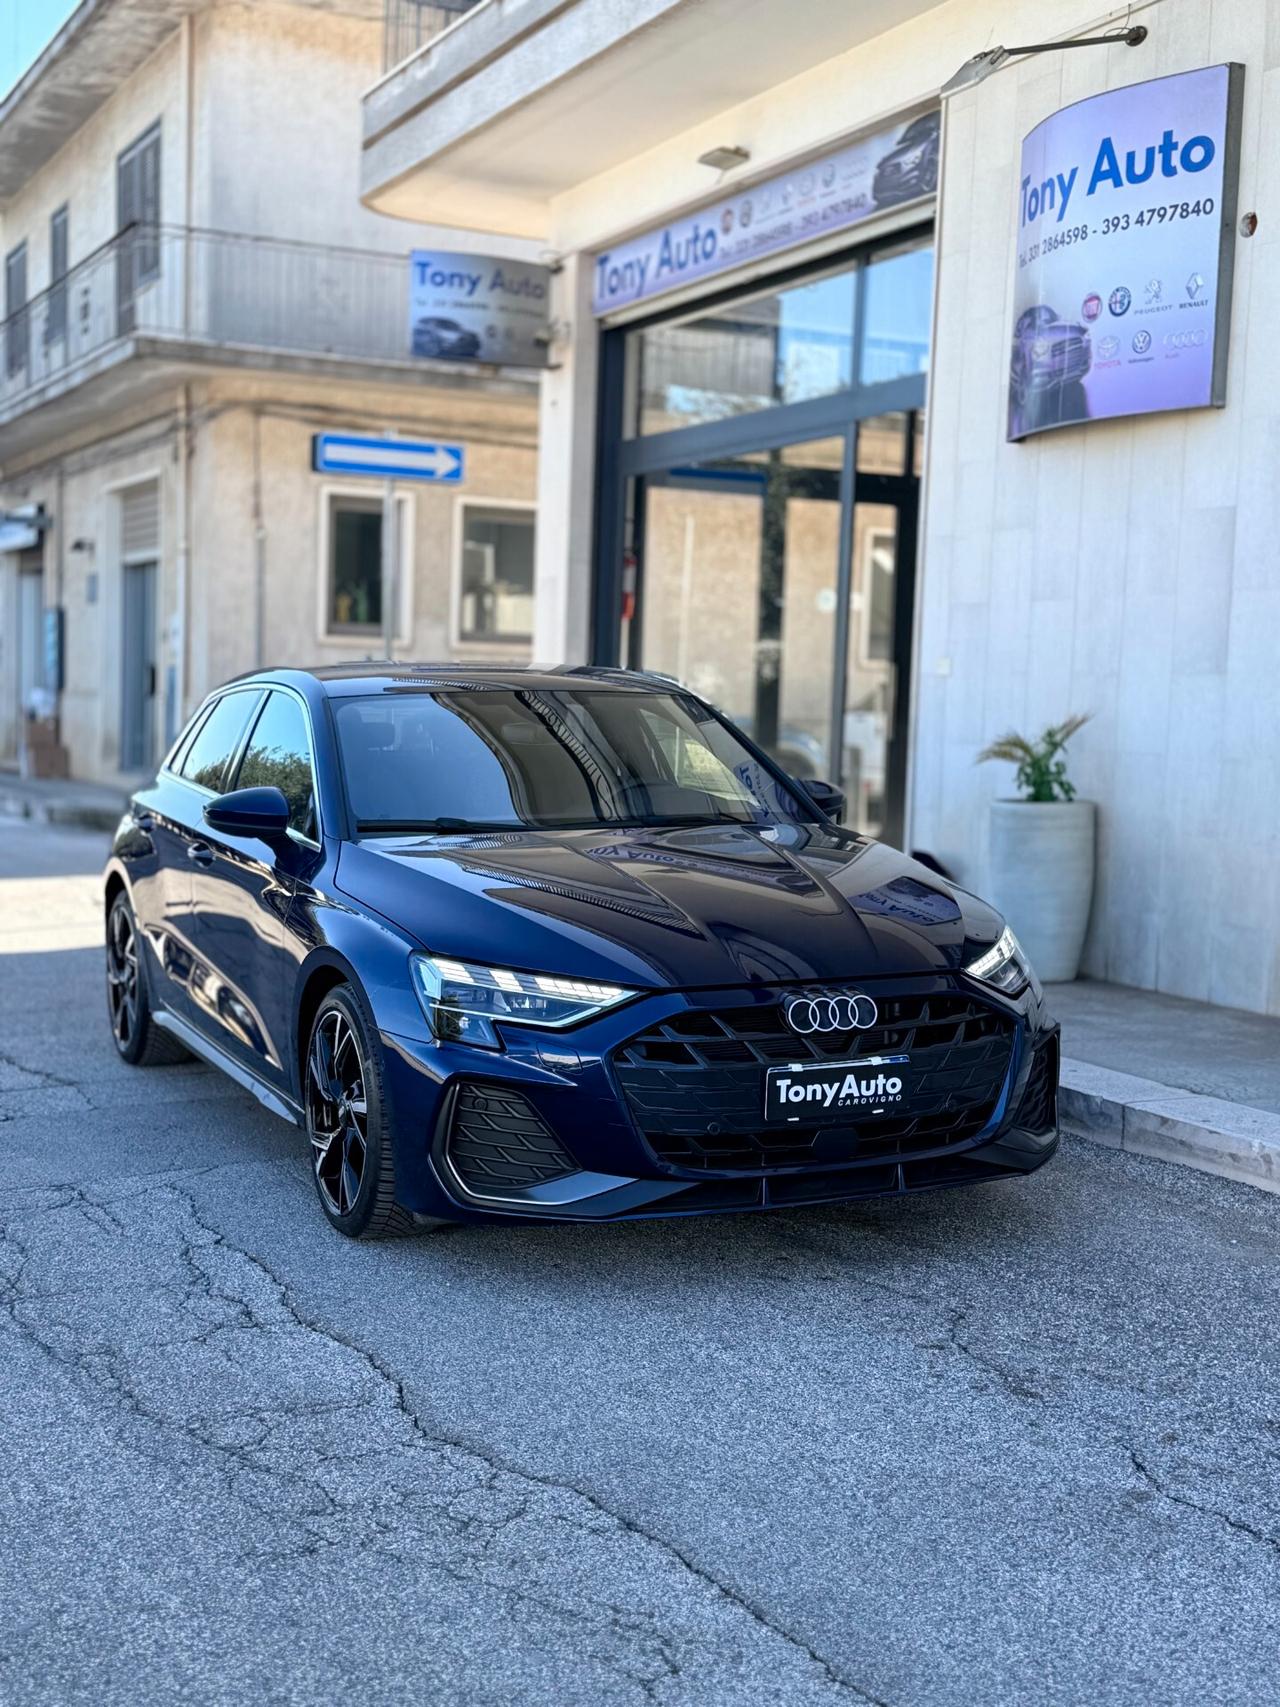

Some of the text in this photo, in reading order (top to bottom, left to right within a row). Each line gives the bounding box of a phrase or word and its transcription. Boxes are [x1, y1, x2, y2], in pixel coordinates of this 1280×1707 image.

[1022, 129, 1216, 228] Tony Auto
[1042, 224, 1089, 257] 2864598
[1101, 213, 1130, 235] 393
[1134, 198, 1215, 228] 4797840
[597, 253, 652, 298] Tony
[655, 224, 717, 279] Auto
[414, 261, 546, 299] Tony Auto
[1134, 304, 1173, 315] PEUGEOT
[1178, 299, 1209, 310] RENAULT
[776, 1074, 902, 1107] TonyAuto
[838, 1095, 902, 1107] CAROVIGNO
